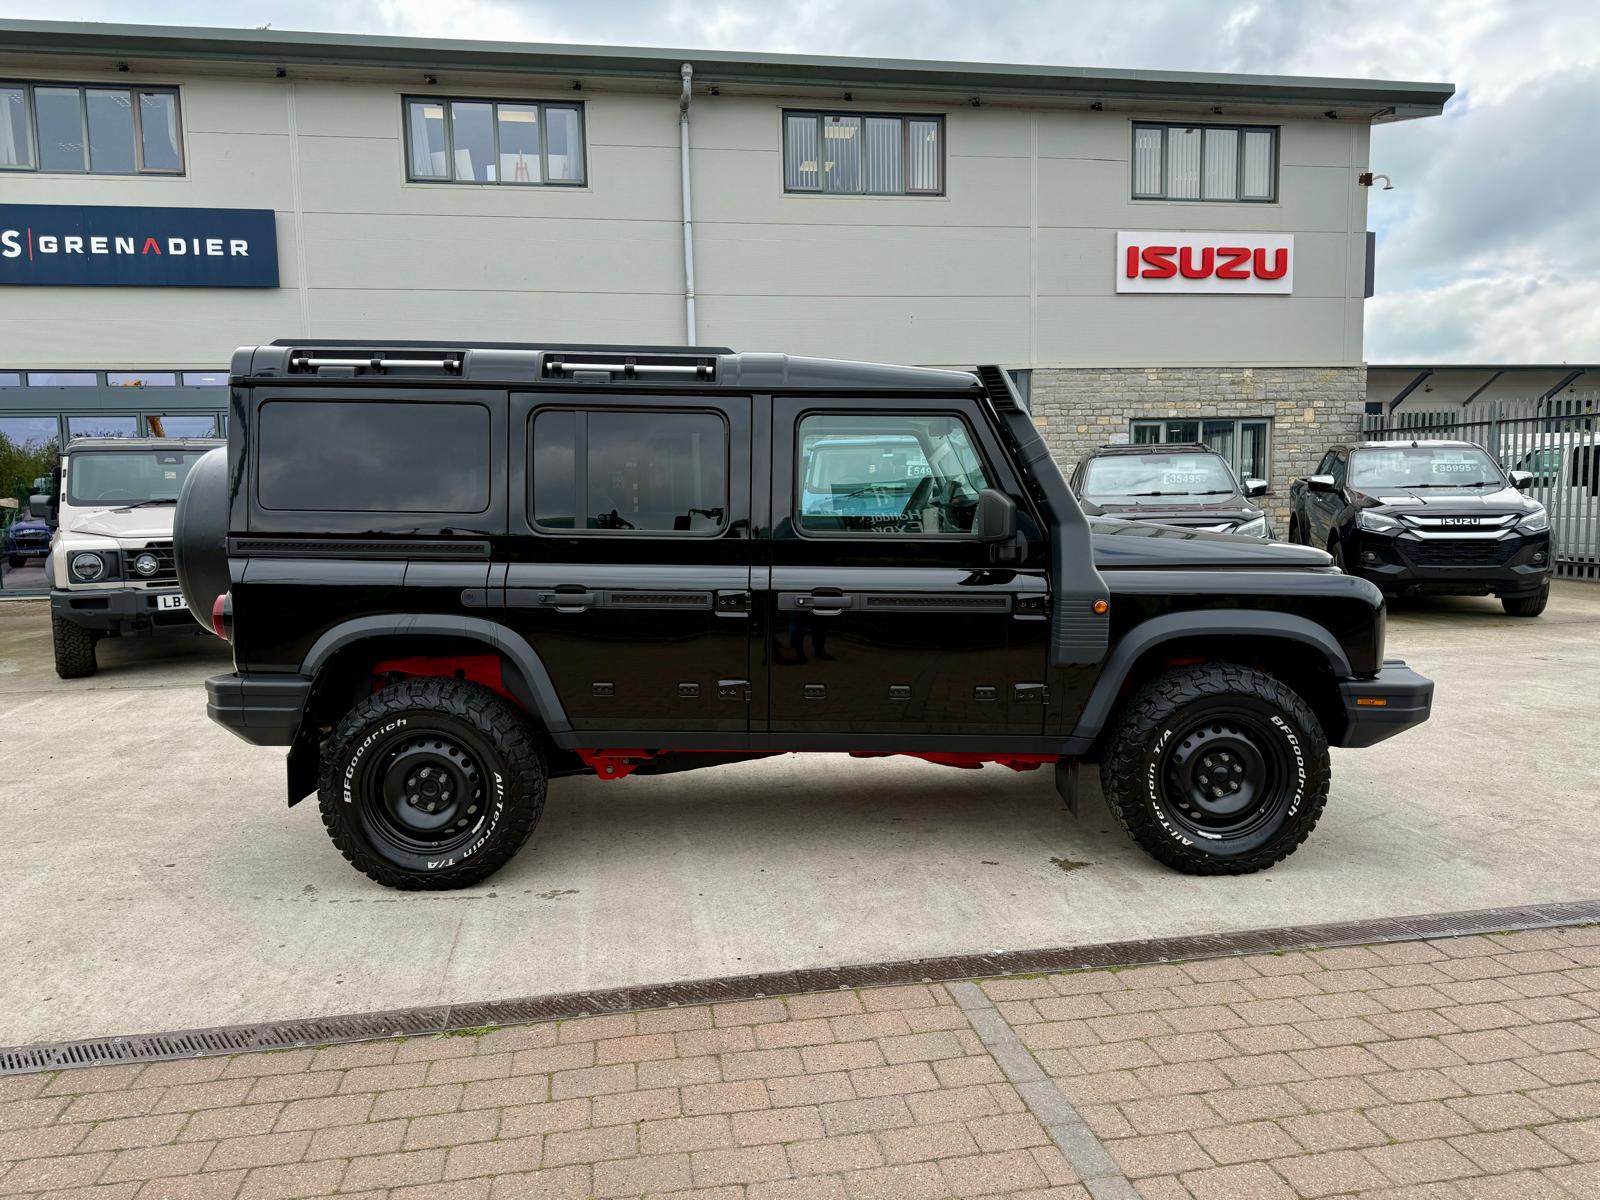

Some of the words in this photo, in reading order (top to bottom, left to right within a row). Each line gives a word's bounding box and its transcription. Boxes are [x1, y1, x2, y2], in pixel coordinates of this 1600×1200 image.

[38, 236, 249, 256] GRENADIER
[1126, 245, 1288, 280] ISUZU
[343, 717, 408, 804] BFGoodrich
[1270, 715, 1308, 818] BFGoodrich
